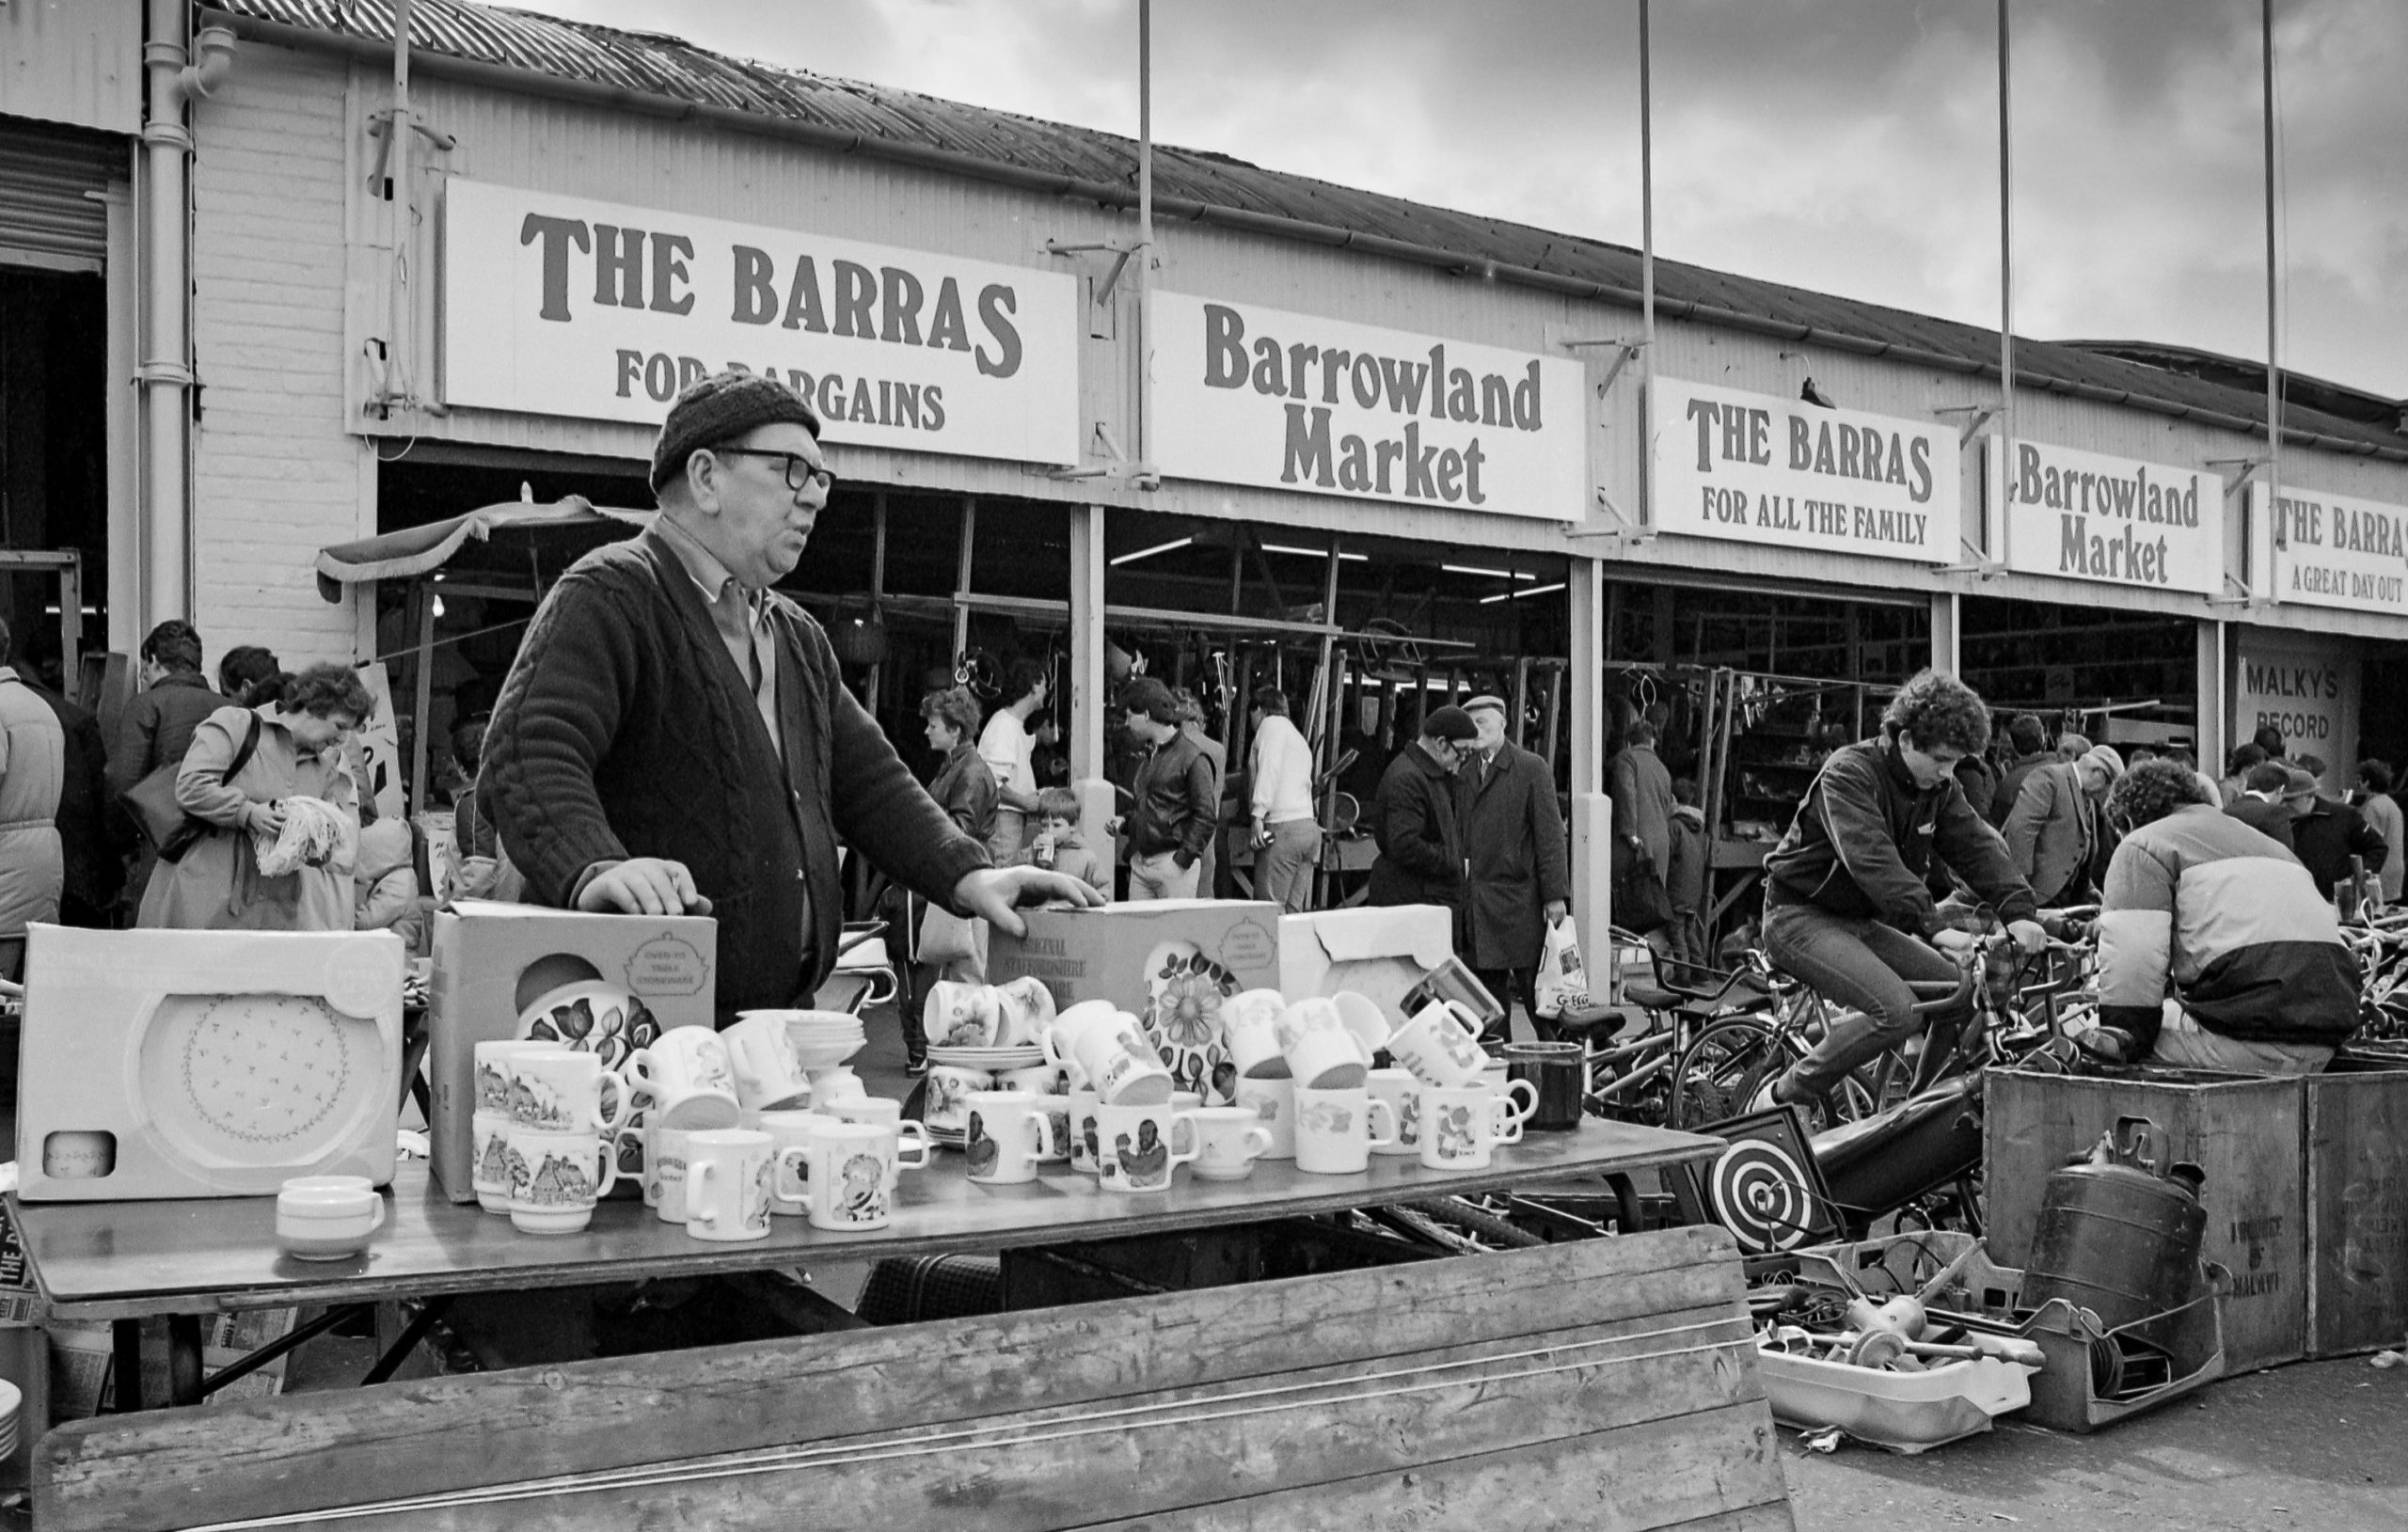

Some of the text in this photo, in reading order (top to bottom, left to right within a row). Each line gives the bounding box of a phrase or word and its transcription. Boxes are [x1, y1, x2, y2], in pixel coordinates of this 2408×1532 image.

[520, 213, 1022, 379] THE BARRAS
[727, 362, 945, 432] RGAINS
[1203, 304, 1543, 433] Barrowland
[1279, 403, 1486, 506] Market
[1687, 397, 1933, 504] THE BARRAS
[2018, 442, 2200, 529] Barrowland
[1702, 485, 1927, 546] FOR ALL THE FAMILY
[2058, 513, 2169, 585] Market
[2276, 496, 2408, 570] THE BARRA
[2291, 564, 2403, 604] A GREAT DAY OUT
[2246, 662, 2338, 700] MALKY'S
[2257, 711, 2330, 739] RECORD
